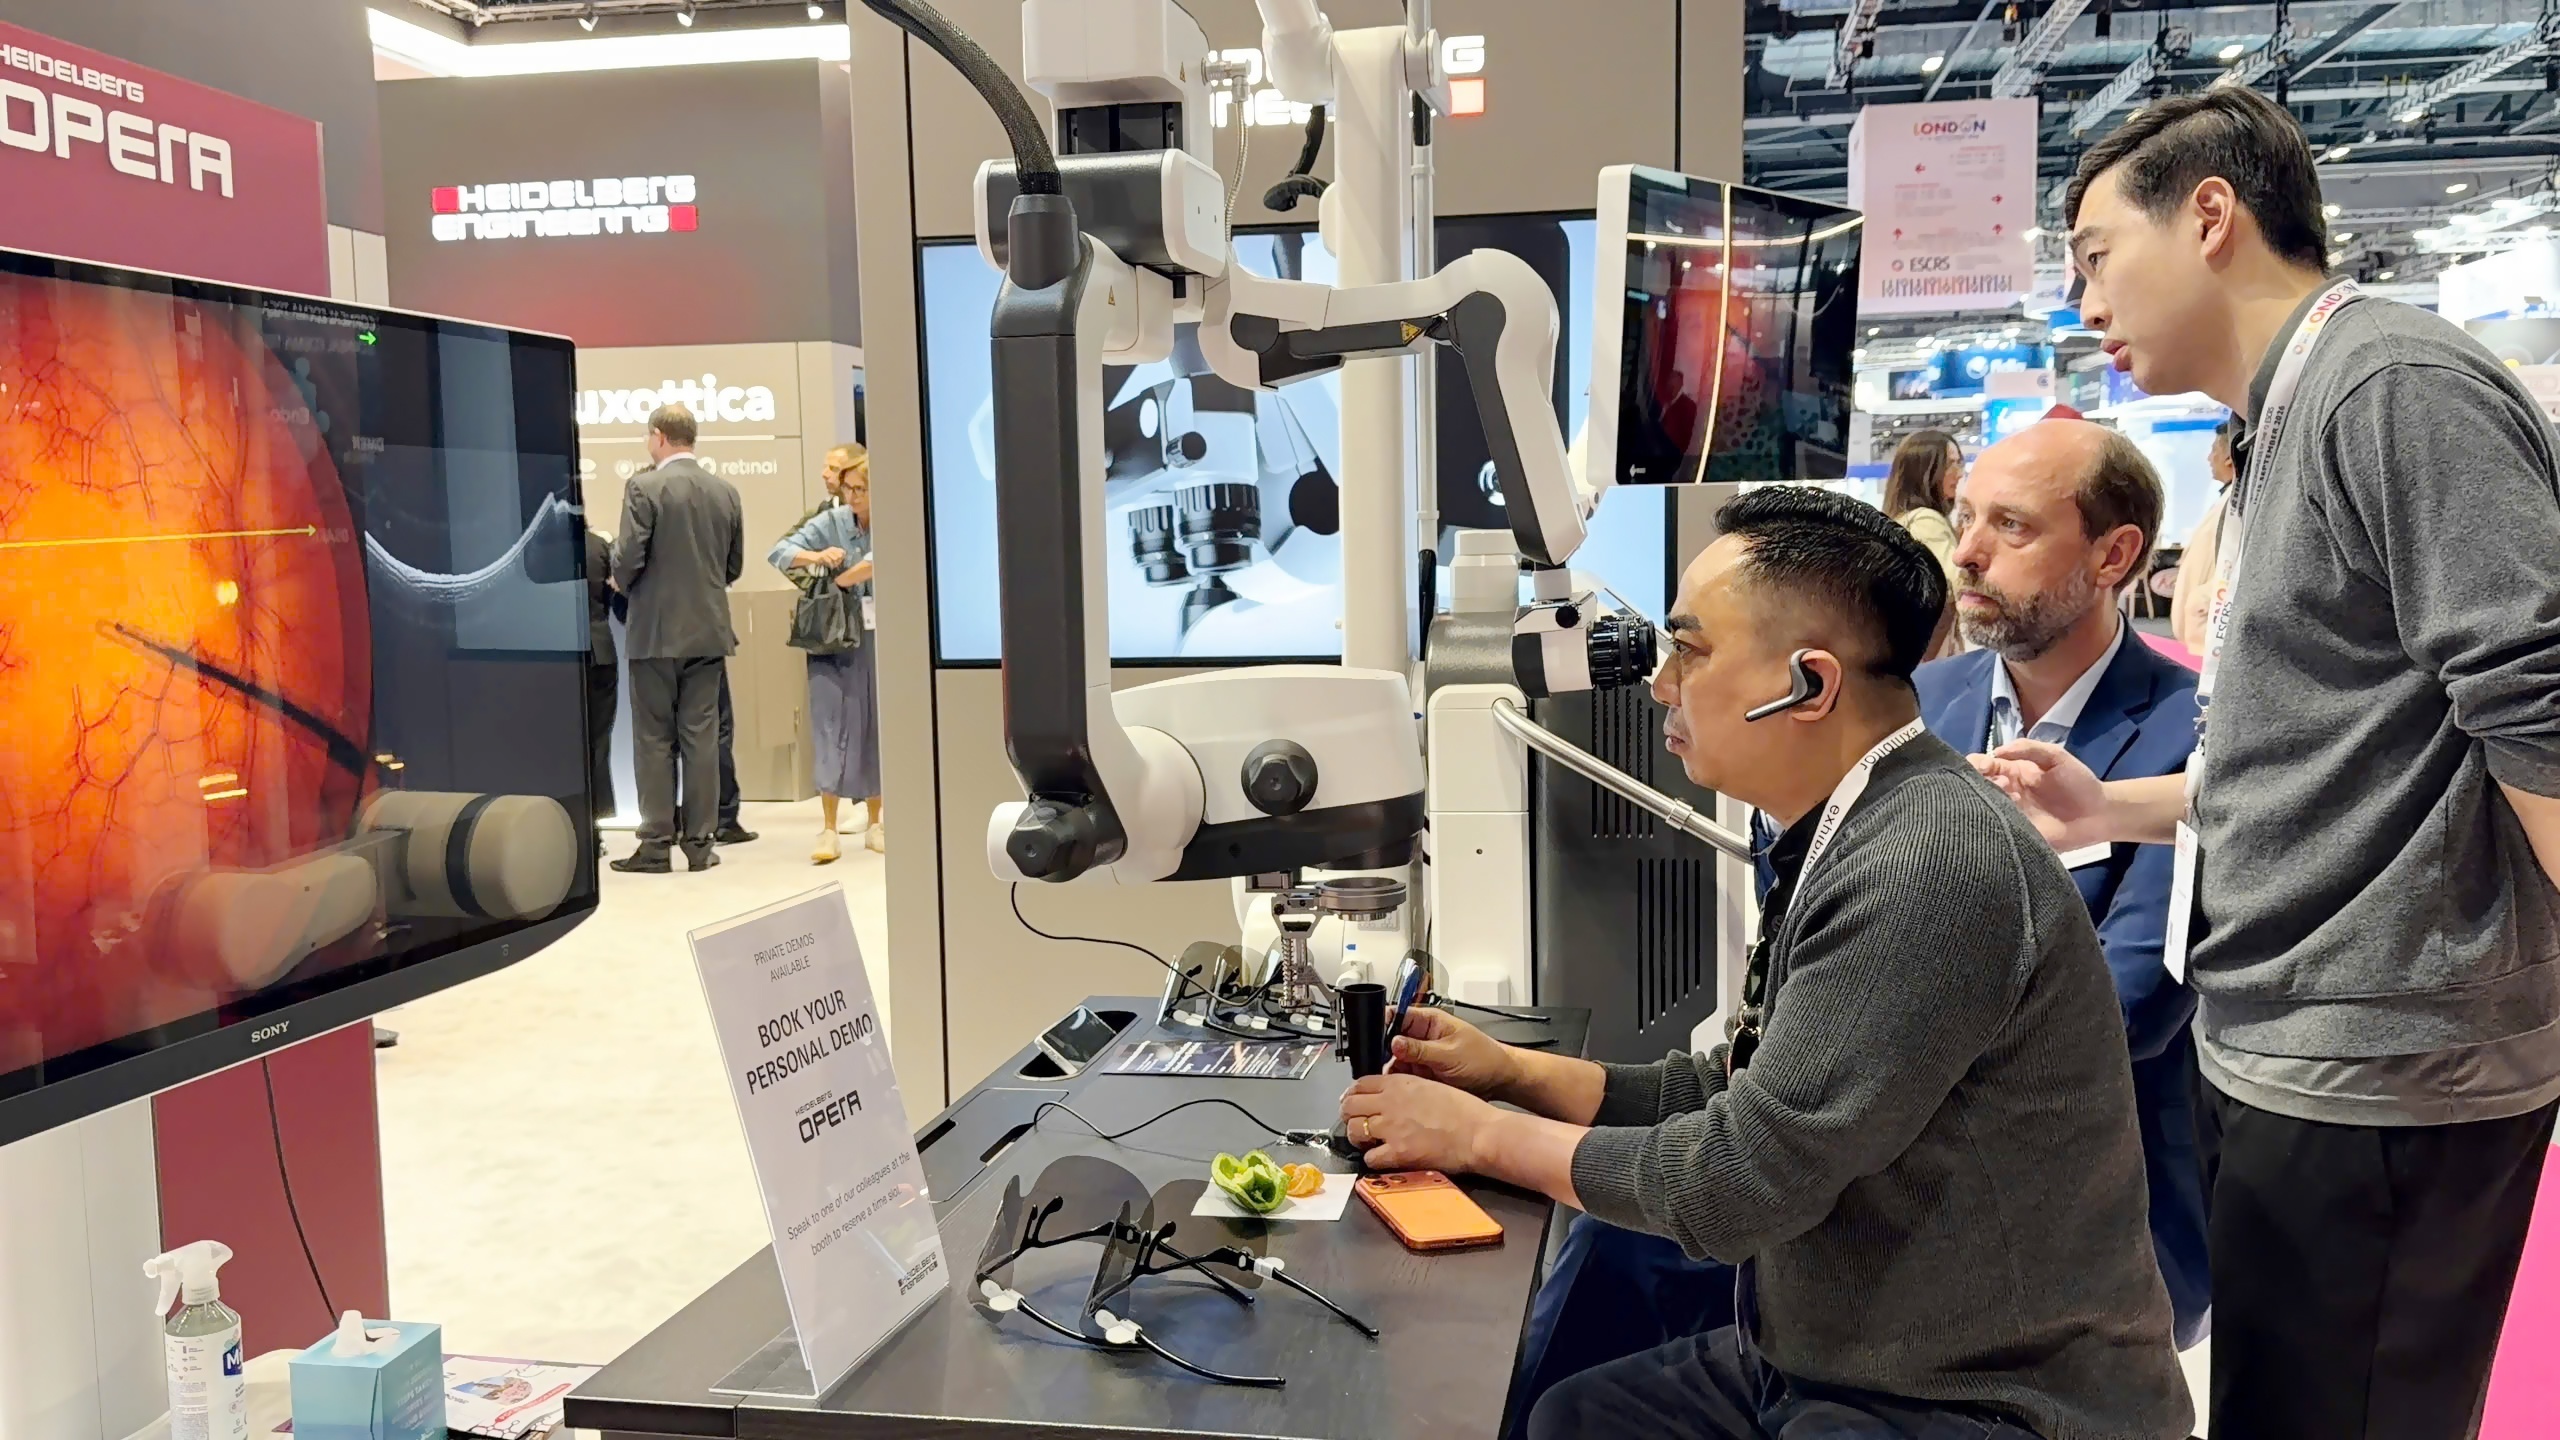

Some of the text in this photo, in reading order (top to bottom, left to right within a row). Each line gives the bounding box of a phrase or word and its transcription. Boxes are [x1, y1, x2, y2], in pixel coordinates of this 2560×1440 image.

[0, 44, 144, 103] HEIDELBERG
[0, 79, 234, 199] OPERA
[458, 175, 697, 212] HEIDELBERG
[432, 205, 669, 241] ENGINEERING
[1910, 256, 1950, 272] ESCRS
[576, 373, 775, 425] uxottica
[1804, 804, 1840, 875] exhibitor
[754, 932, 815, 966] PRIVATE DEMOS
[770, 955, 811, 983] AVAILABLE
[251, 1020, 290, 1043] SONY
[758, 989, 847, 1048] BOOK YOUR
[746, 1013, 873, 1095] PERSONAL DEMO
[795, 1089, 833, 1117] HEIDELBERG
[799, 1089, 862, 1144] OPERA
[787, 1151, 911, 1240] Speak to one of our colleagues at the
[811, 1232, 832, 1256] booth
[832, 1227, 841, 1240] to
[841, 1210, 867, 1232] reserve
[866, 1207, 873, 1216] a
[872, 1195, 887, 1211] time
